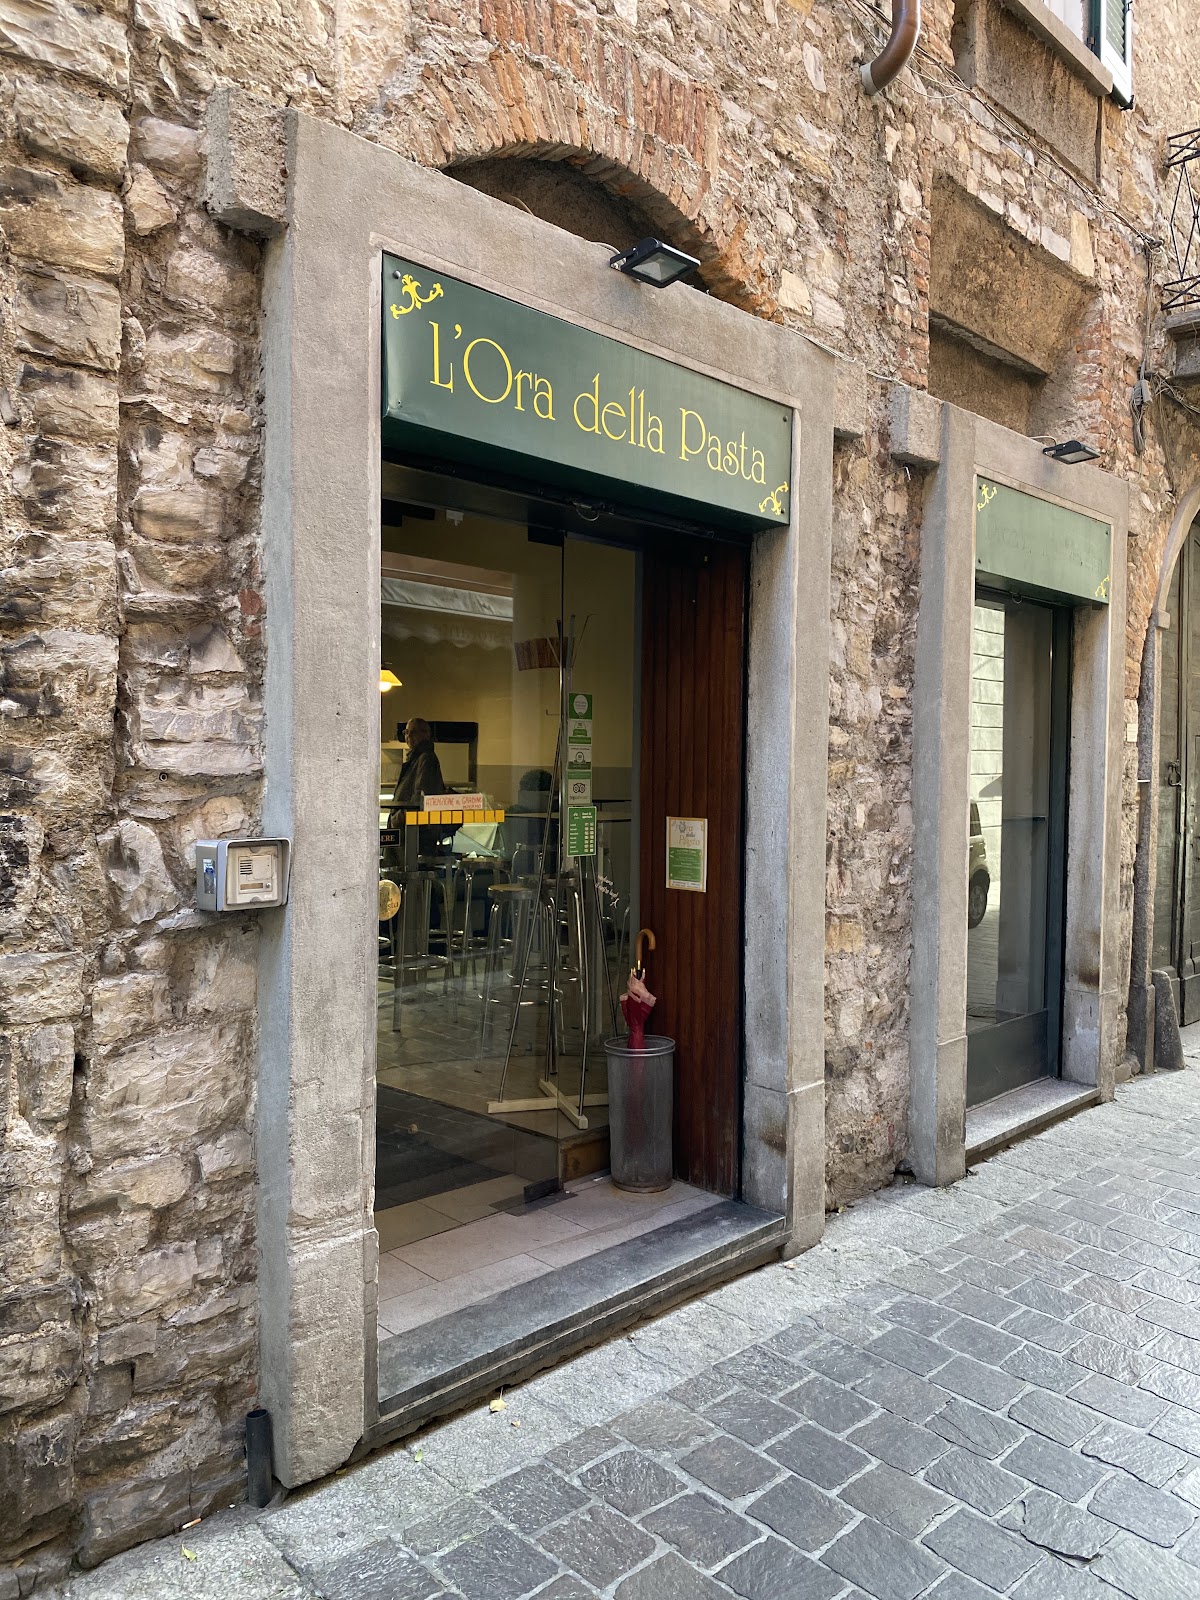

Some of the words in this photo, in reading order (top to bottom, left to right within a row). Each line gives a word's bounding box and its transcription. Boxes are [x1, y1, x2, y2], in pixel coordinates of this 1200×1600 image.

[429, 321, 556, 422] L'Ora
[573, 373, 666, 456] della
[679, 406, 768, 486] Pasta
